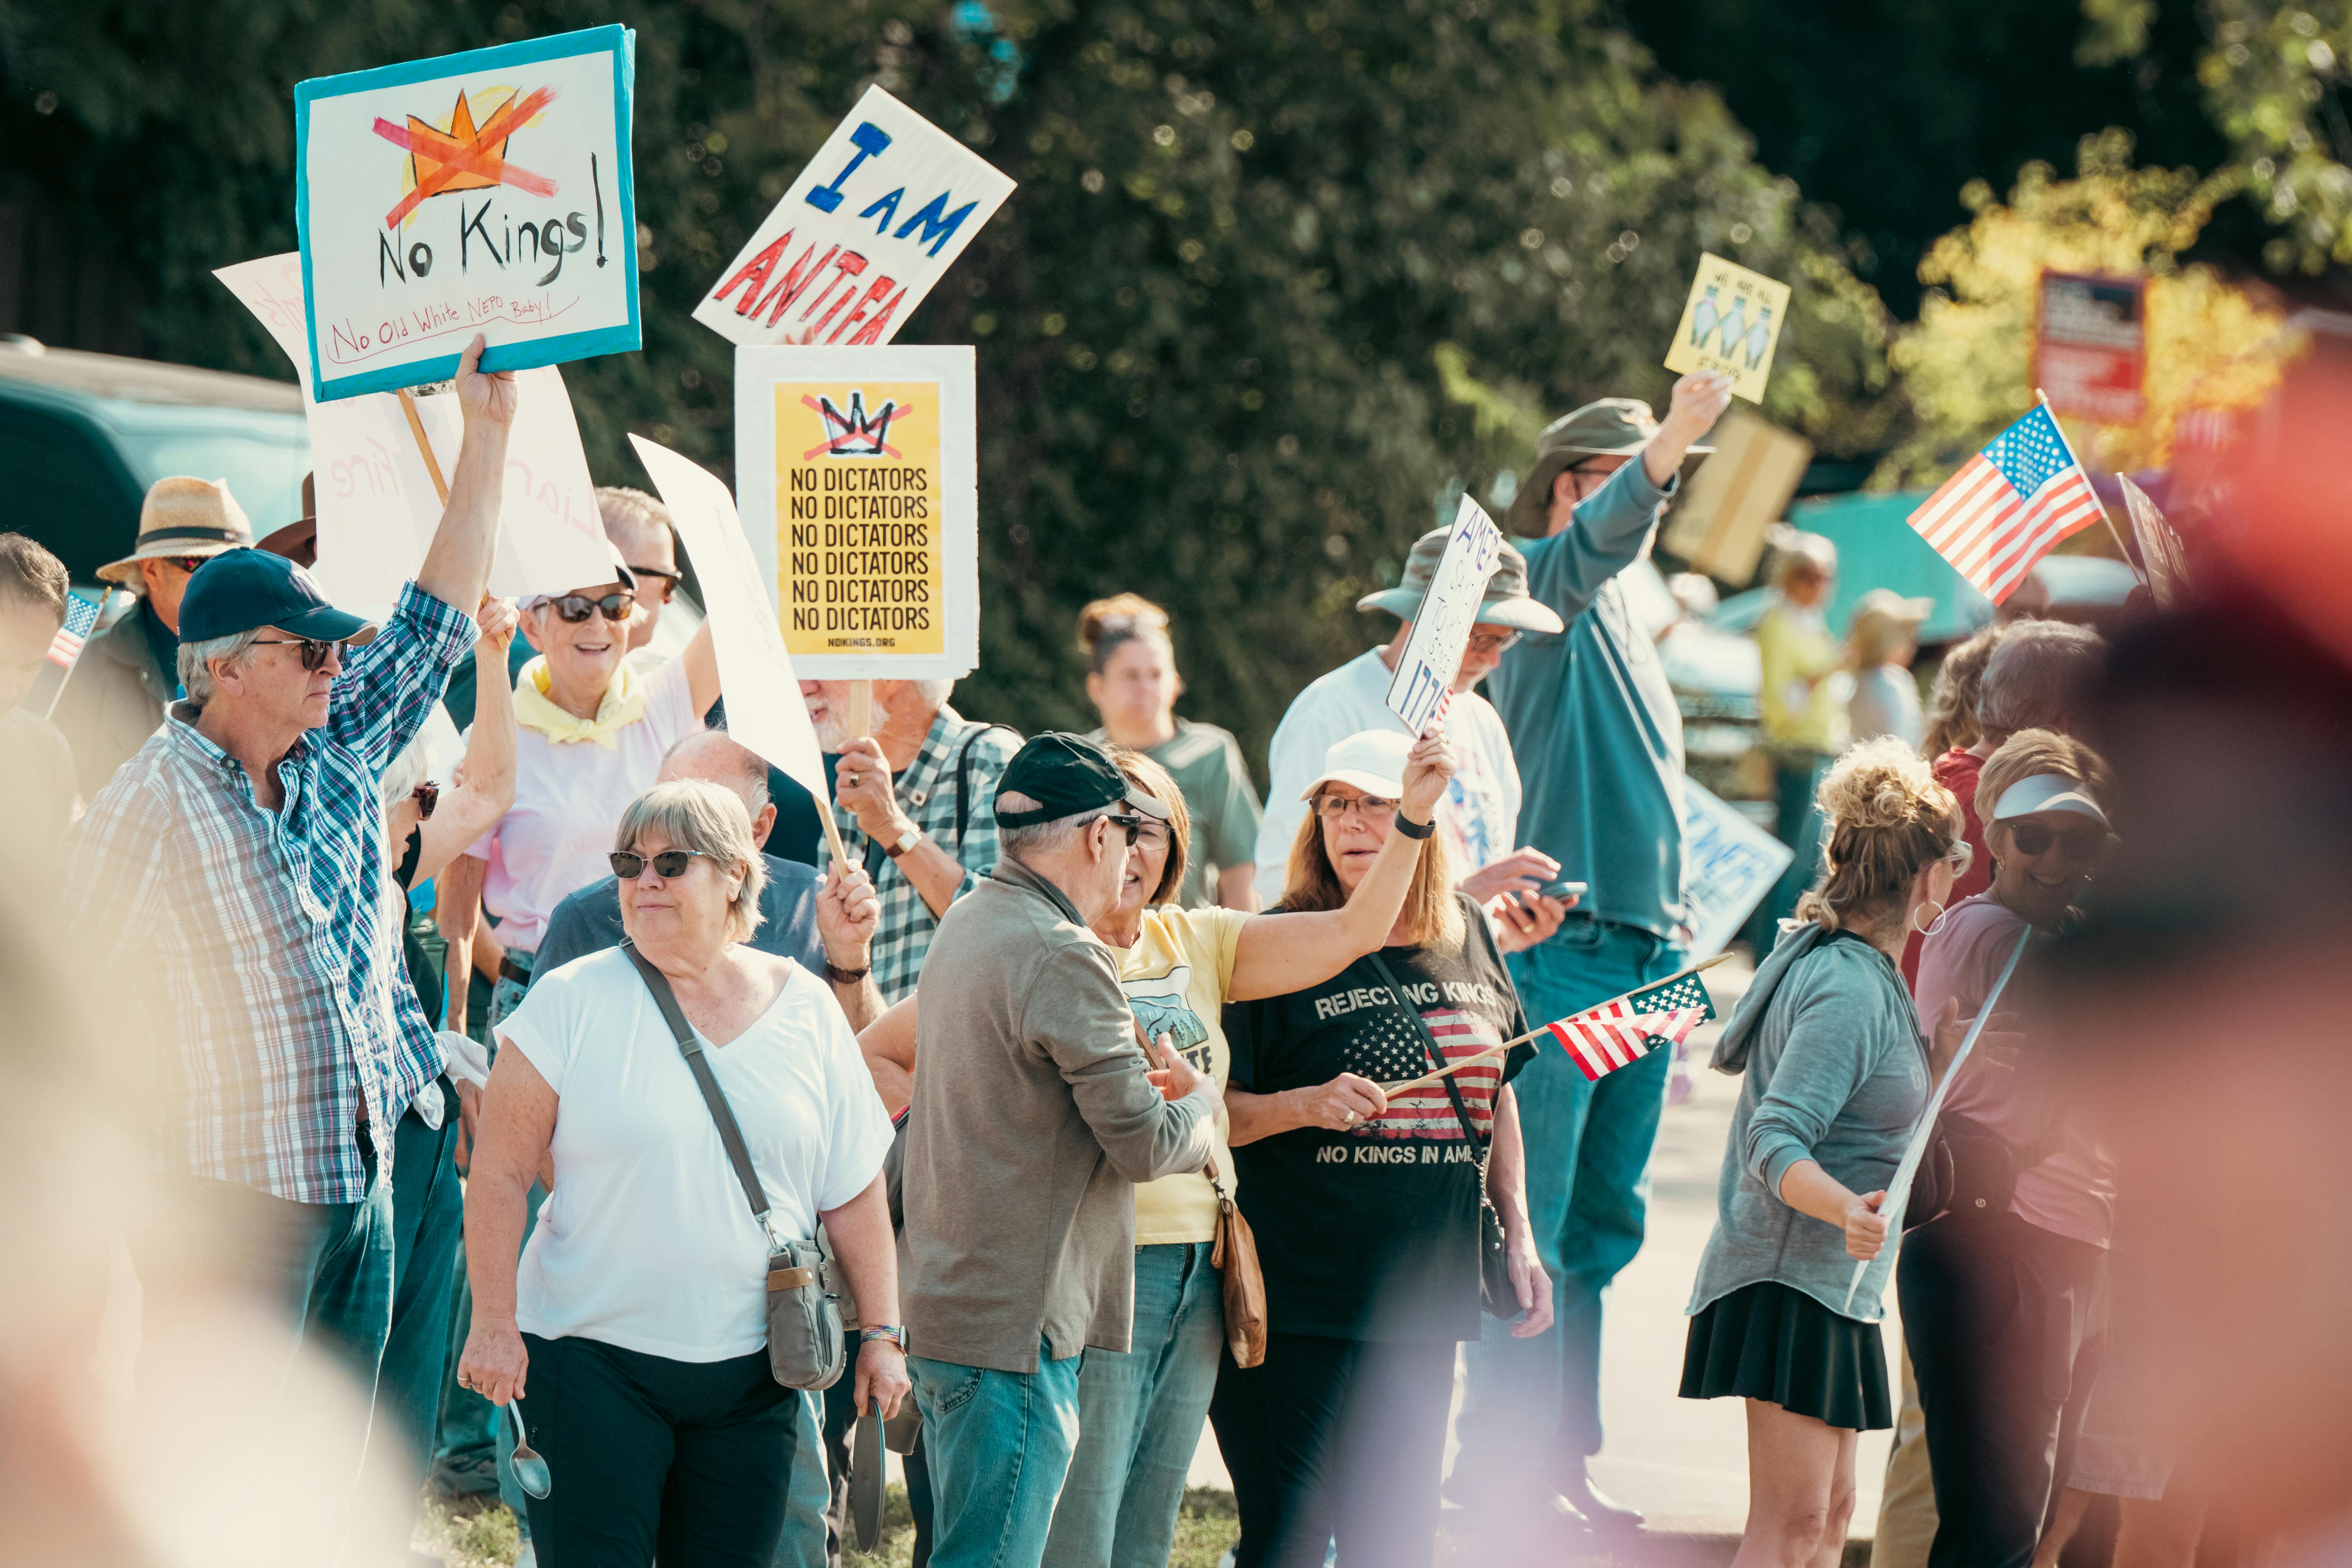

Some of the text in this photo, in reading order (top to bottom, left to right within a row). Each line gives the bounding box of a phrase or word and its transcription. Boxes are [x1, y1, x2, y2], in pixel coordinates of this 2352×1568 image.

[805, 121, 981, 258] I AM
[379, 152, 609, 289] No Kings!
[712, 228, 908, 345] ANTIFA
[332, 292, 552, 359] No Old White NEPO Baby!
[792, 468, 927, 491] NO DICTATORS
[792, 496, 928, 519] NO DICTATORS
[792, 523, 928, 547] NO DICTATORS
[793, 551, 928, 575] NO DICTATORS
[793, 579, 929, 603] NO DICTATORS
[794, 607, 929, 630] NO DICTATORS
[828, 638, 895, 647] NOKINGS.ORG
[1315, 981, 1496, 1020] REJECTNG KINGS
[1316, 1146, 1348, 1163] NO
[1354, 1146, 1416, 1164] KINGS
[1421, 1146, 1439, 1164] IN
